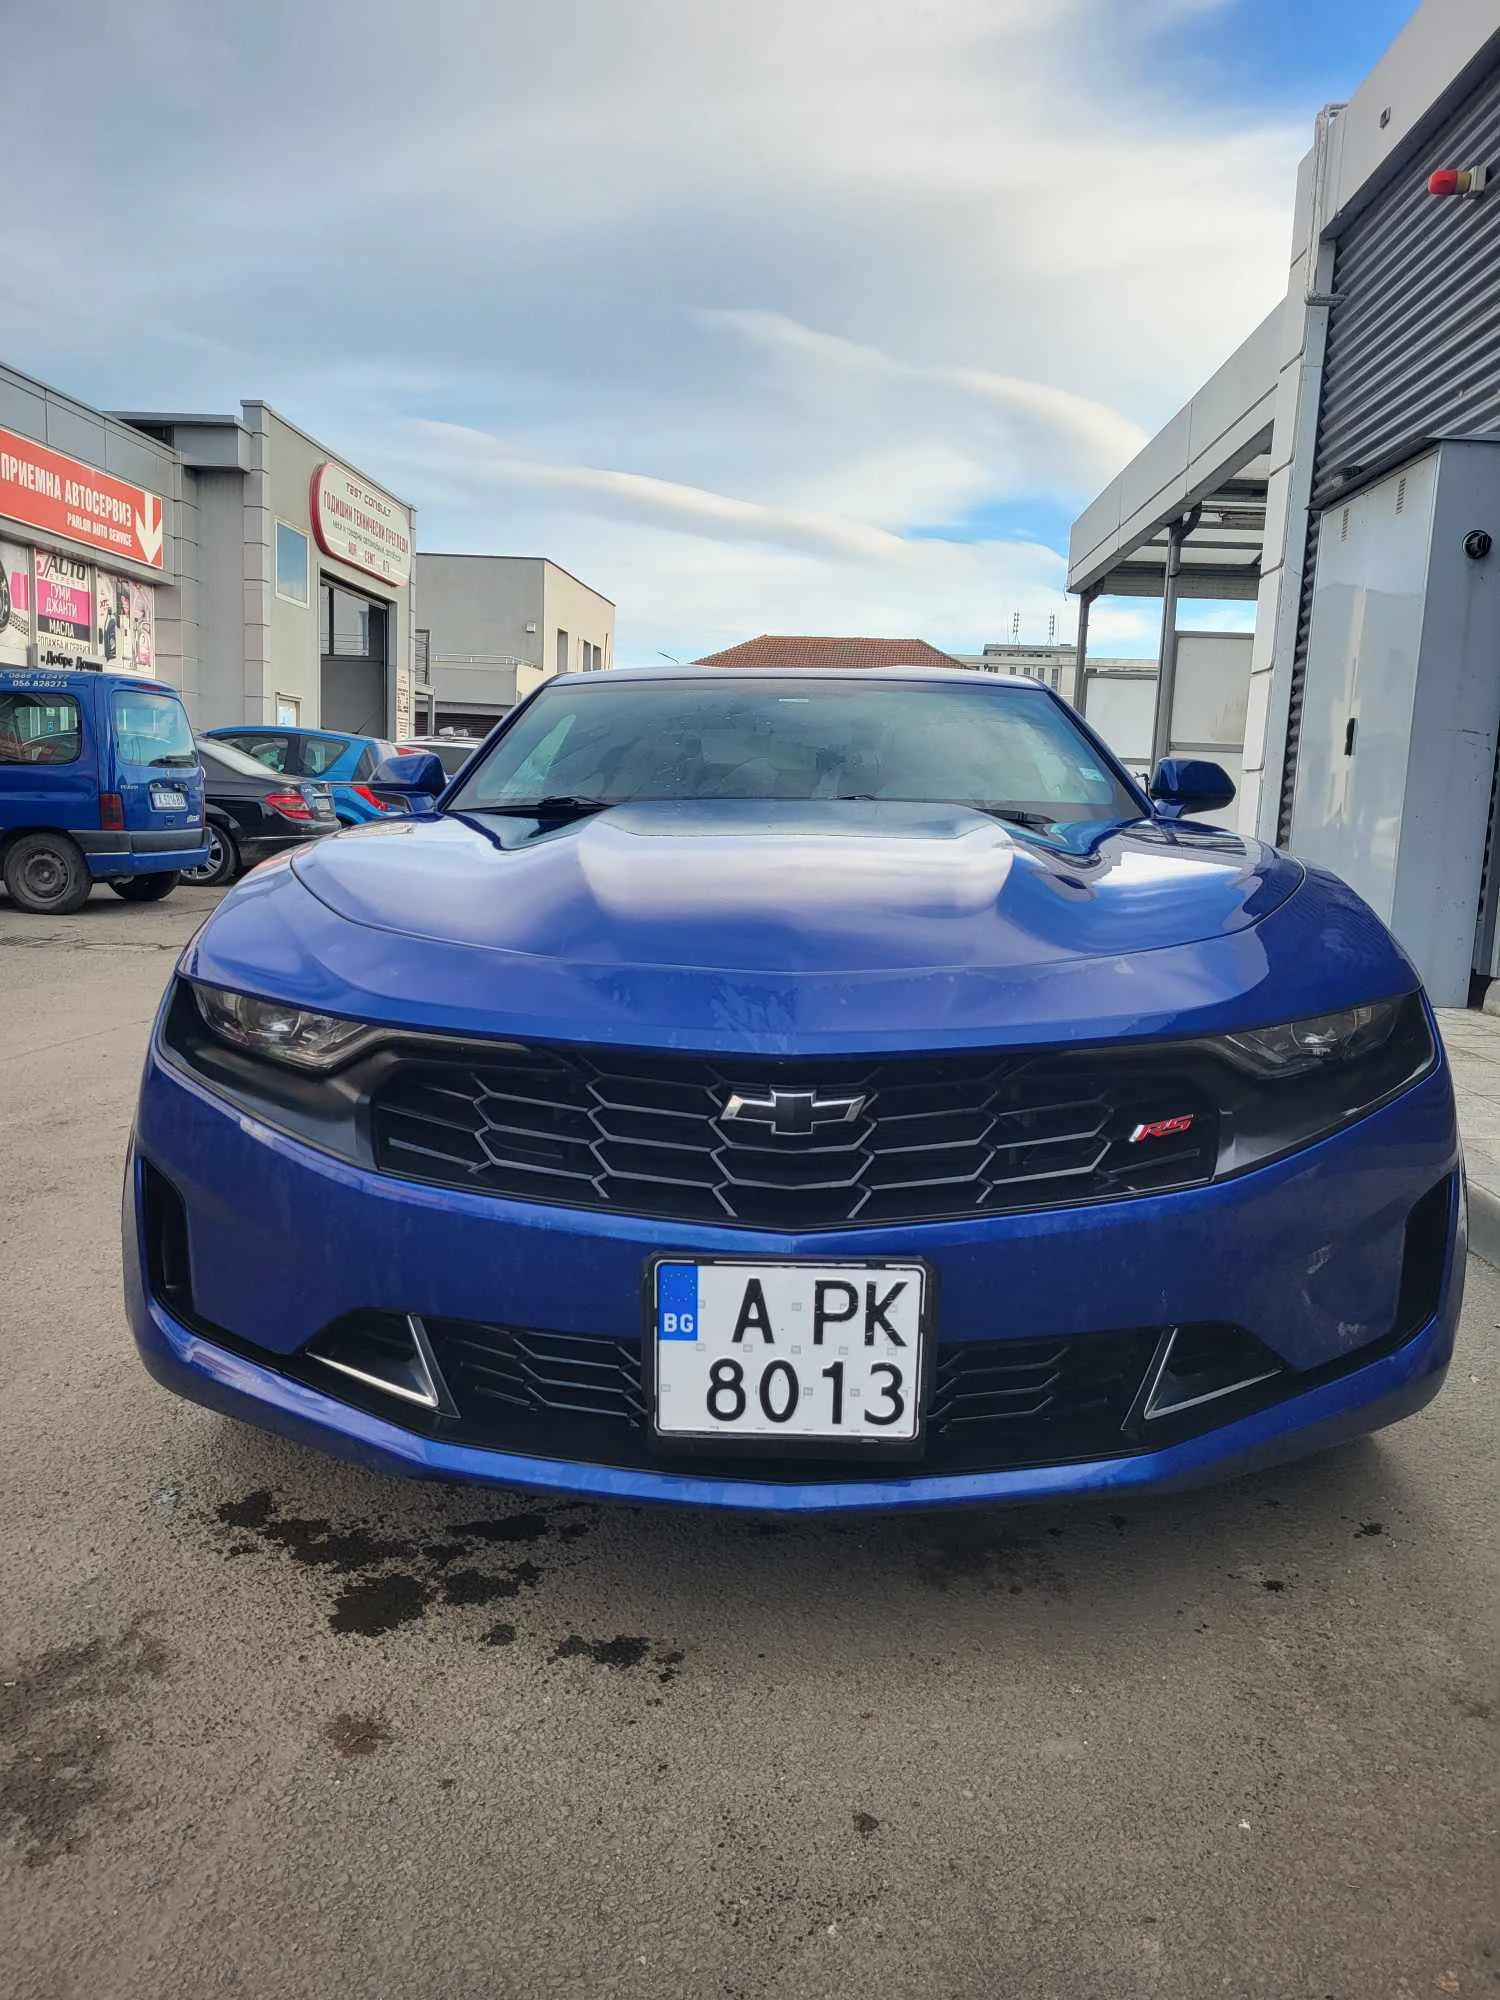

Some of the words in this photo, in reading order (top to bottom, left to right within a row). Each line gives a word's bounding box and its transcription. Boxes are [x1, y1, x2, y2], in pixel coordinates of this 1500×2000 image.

[1, 453, 62, 500] ПРИЕМНА
[65, 480, 132, 527] АВТОСЕРВИЗ
[67, 512, 92, 533] PARLOR
[93, 524, 108, 538] AUTO
[109, 529, 132, 547] SERVICE
[46, 557, 86, 581] AUTO
[50, 583, 71, 601] ГУМИ
[46, 598, 77, 618] ДЖАНТИ
[49, 618, 75, 638] МАСЛА
[1134, 1113, 1194, 1142] RS
[663, 1312, 694, 1333] BG
[731, 1278, 775, 1344] A
[813, 1280, 908, 1347] PK
[706, 1358, 905, 1426] 8013
